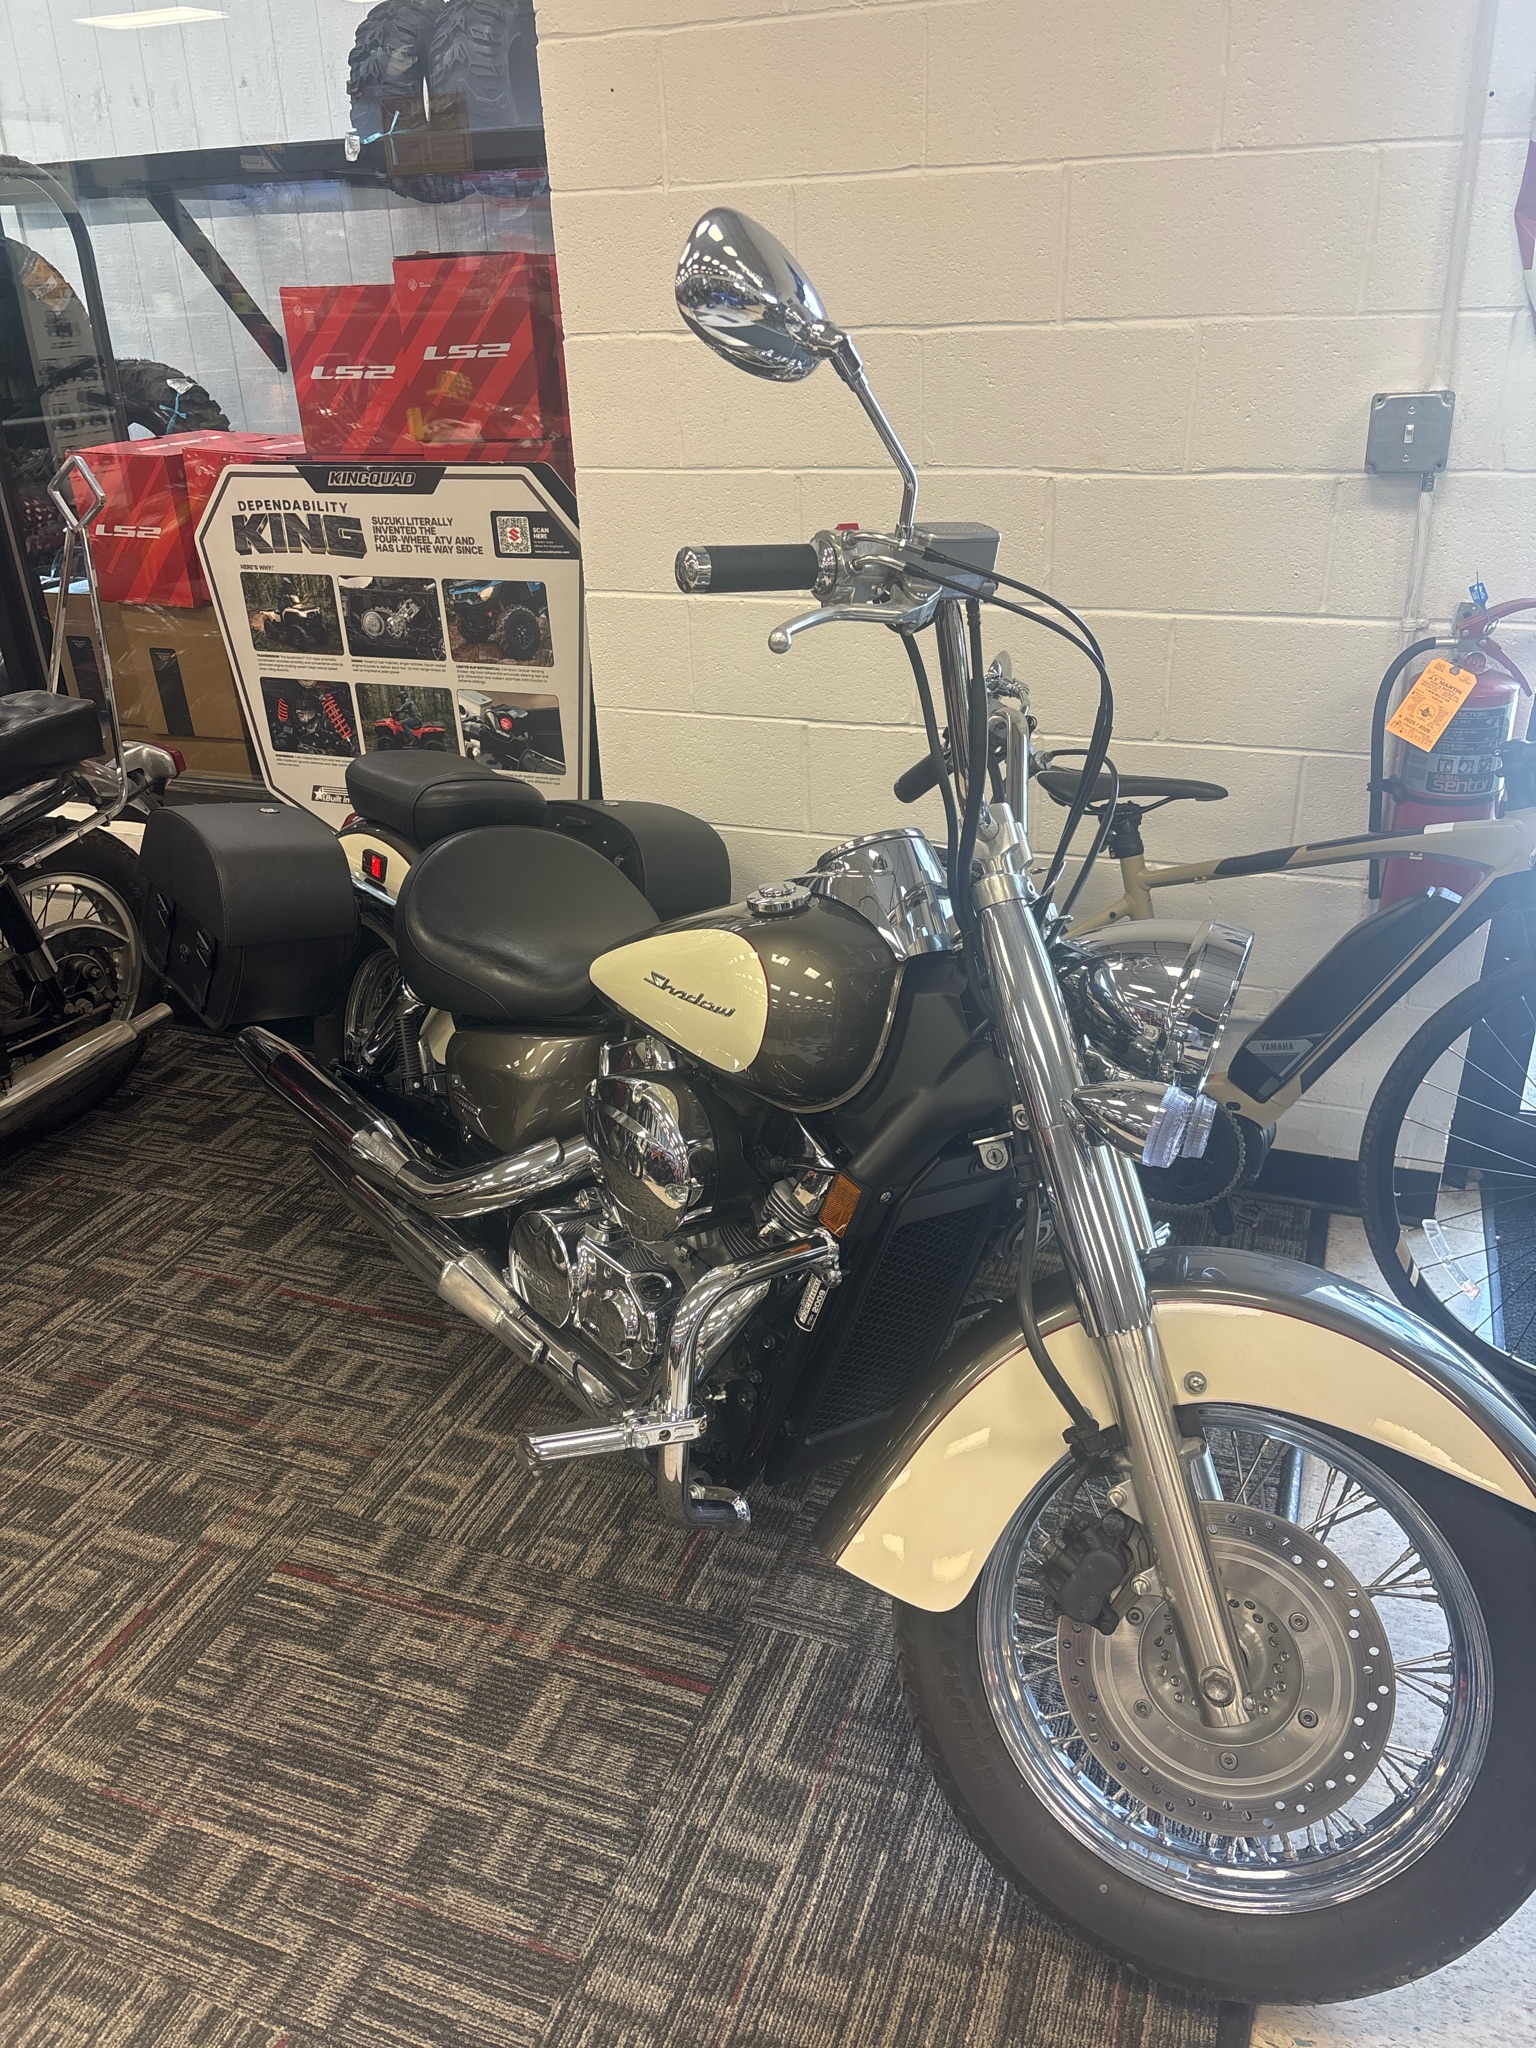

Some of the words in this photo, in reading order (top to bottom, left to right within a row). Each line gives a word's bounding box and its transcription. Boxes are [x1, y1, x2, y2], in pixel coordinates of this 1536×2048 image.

[423, 342, 511, 360] LS2
[310, 366, 396, 380] LS2
[328, 471, 416, 487] KINGQUAD
[237, 500, 348, 513] DEPENDABILITY
[372, 516, 405, 525] SUZUKI
[406, 517, 454, 526] LITERALLY
[96, 524, 162, 539] LS2
[232, 512, 367, 559] KING
[372, 526, 417, 535] INVENTED
[418, 526, 436, 535] THE
[374, 535, 433, 544] FOUR-WHEEL
[434, 536, 452, 545] ATV
[455, 536, 475, 545] AND
[375, 544, 395, 553] HAS
[396, 544, 413, 553] LED
[414, 544, 432, 553] THE
[433, 545, 454, 554] WAY
[456, 546, 484, 555] SINCE
[1439, 681, 1463, 695] MARTIN
[1404, 716, 1416, 726] 2025
[1418, 724, 1431, 734] 2026
[326, 795, 342, 803] Built
[644, 970, 736, 1017] Shadow
[1260, 1042, 1294, 1051] YAMAHA
